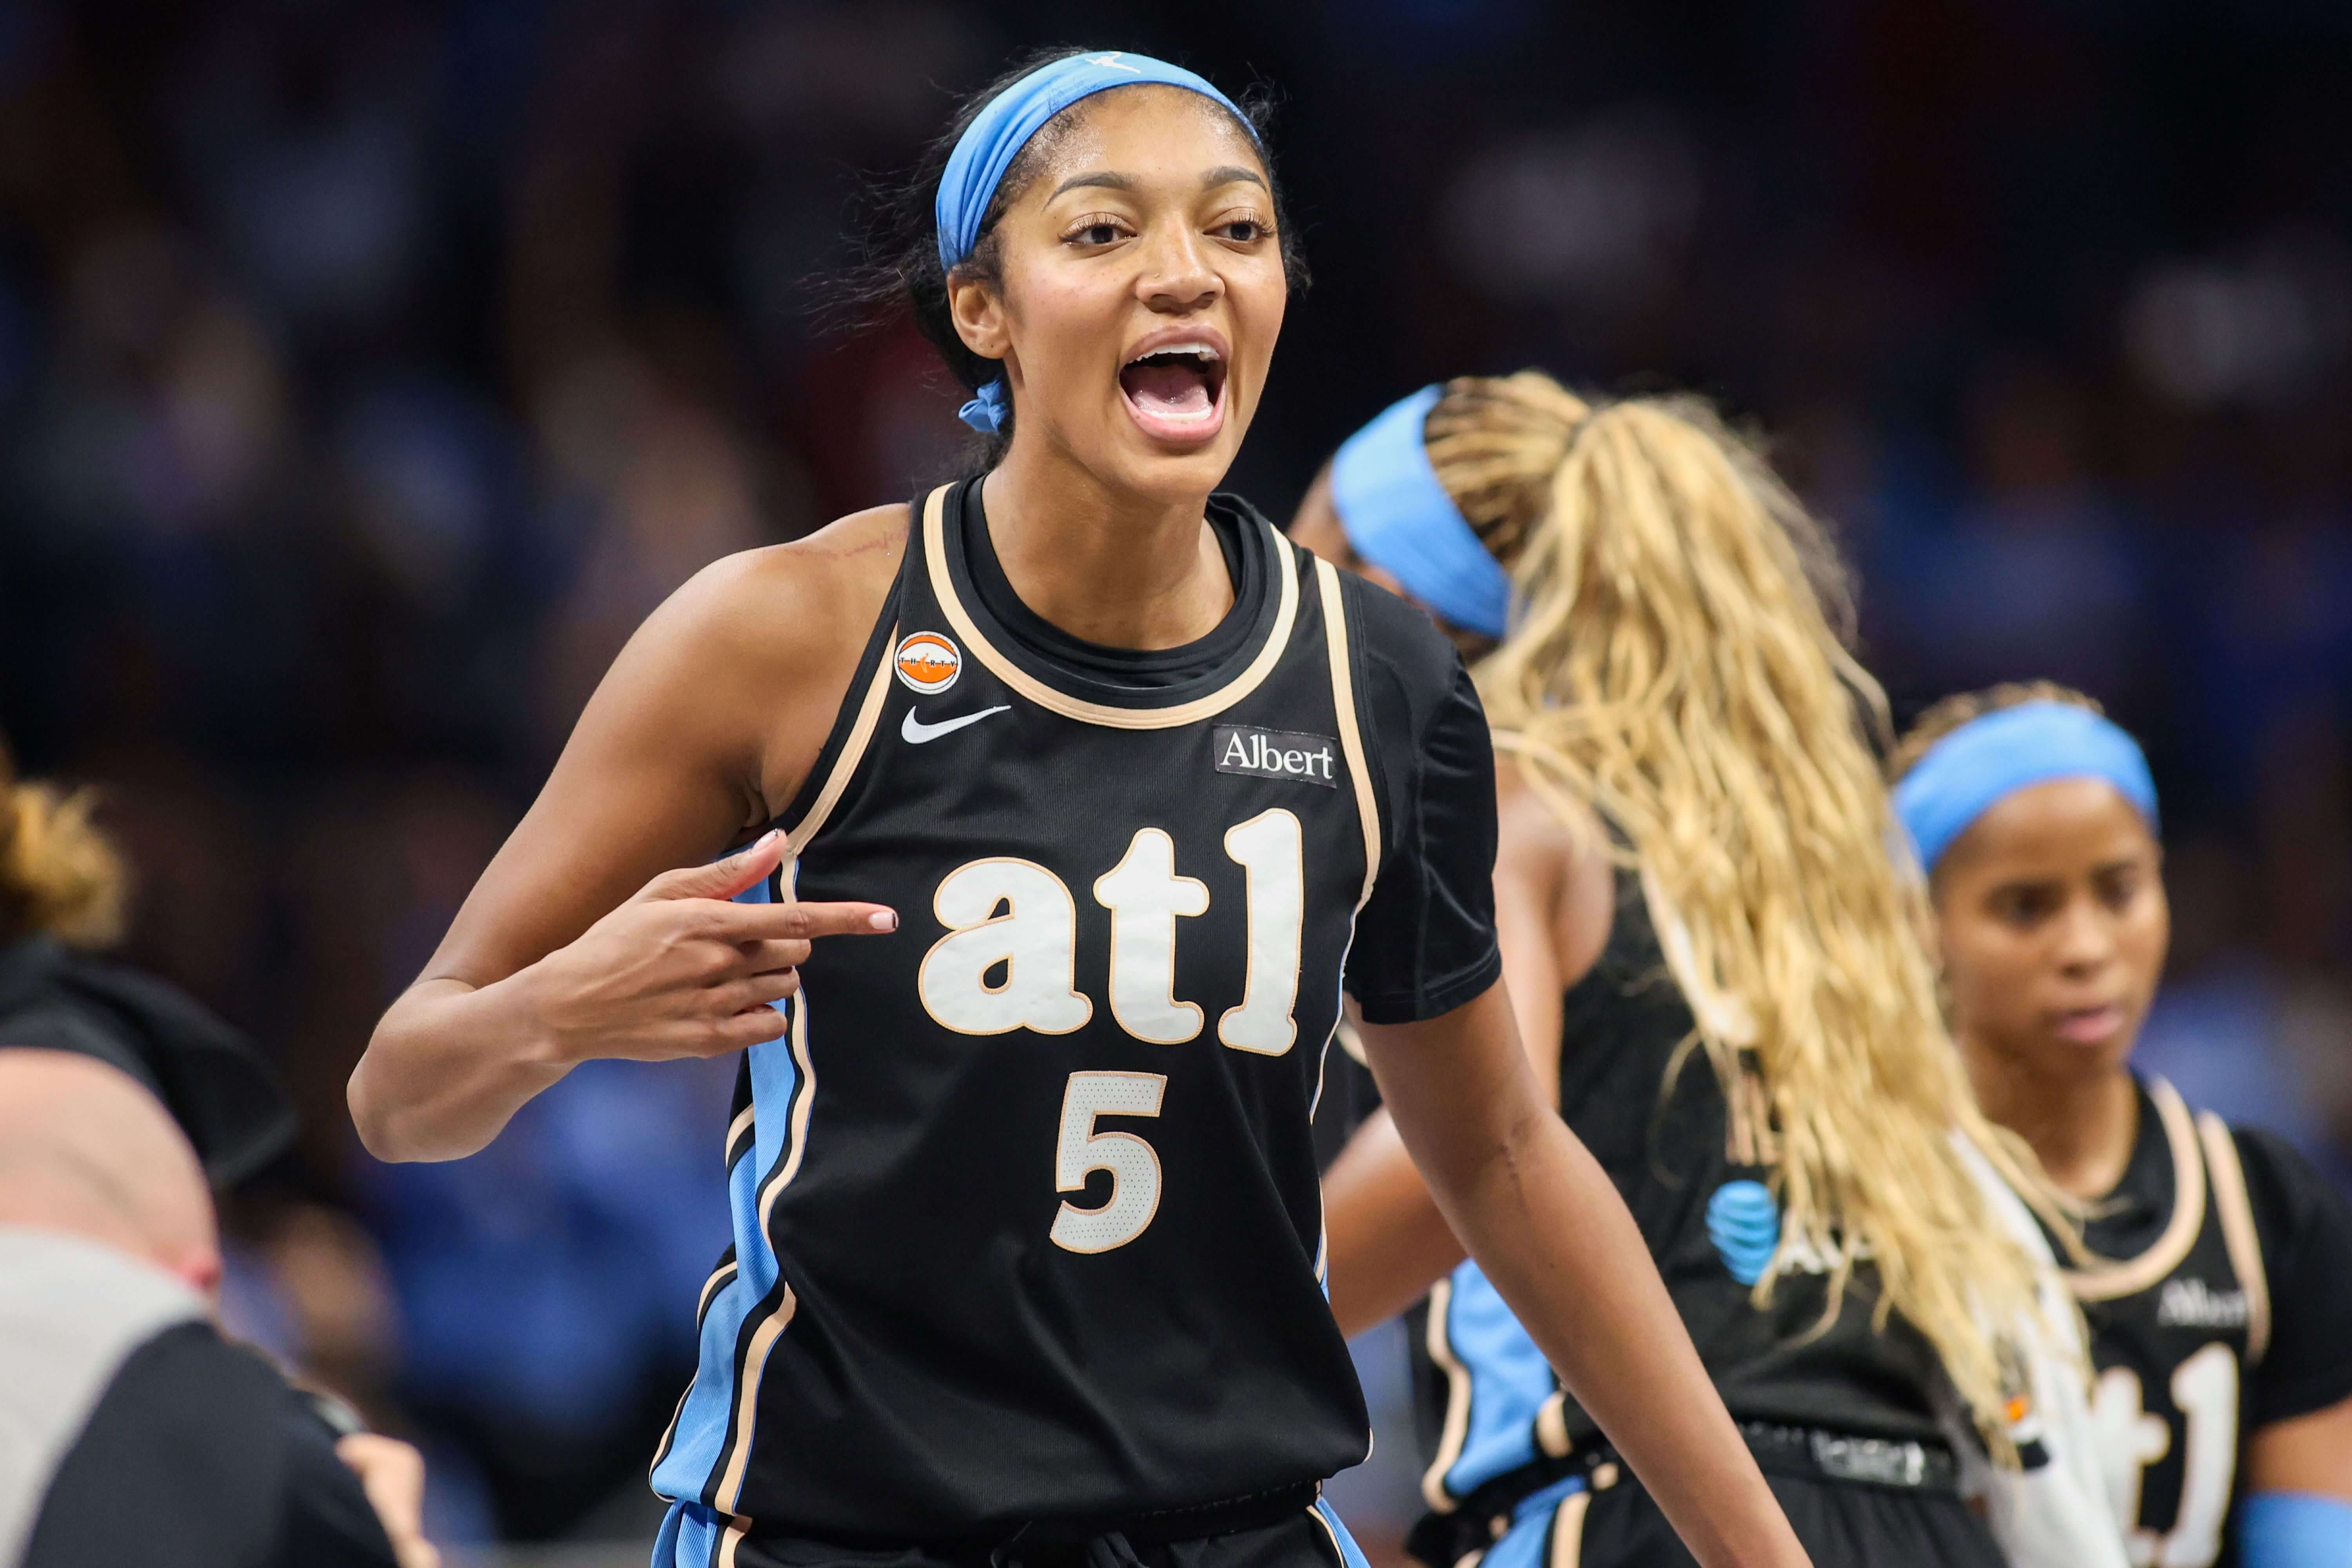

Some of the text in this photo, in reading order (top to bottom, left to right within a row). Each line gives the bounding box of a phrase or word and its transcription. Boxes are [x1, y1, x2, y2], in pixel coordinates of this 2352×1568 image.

[1220, 731, 1332, 779] Albert
[918, 808, 1304, 1056] atl
[1049, 1071, 1167, 1254] 5
